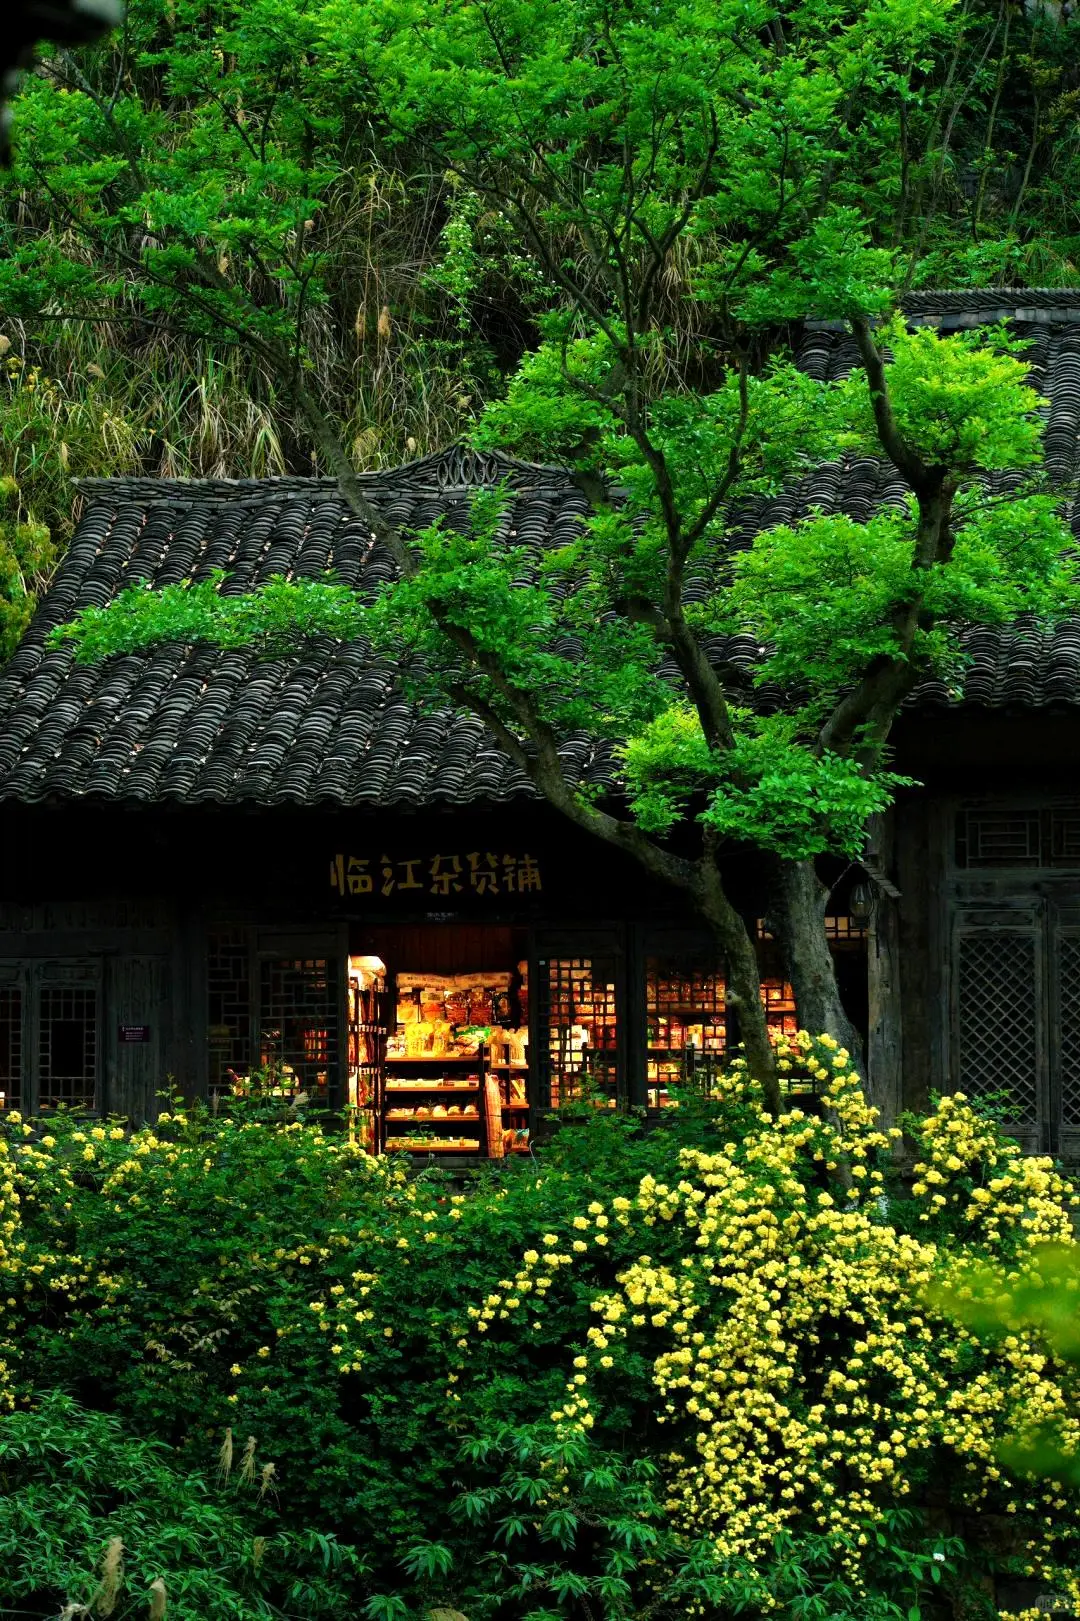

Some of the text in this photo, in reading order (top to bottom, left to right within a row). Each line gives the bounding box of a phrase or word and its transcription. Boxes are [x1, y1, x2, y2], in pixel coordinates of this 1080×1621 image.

[330, 852, 542, 897] 临江杂货铺
